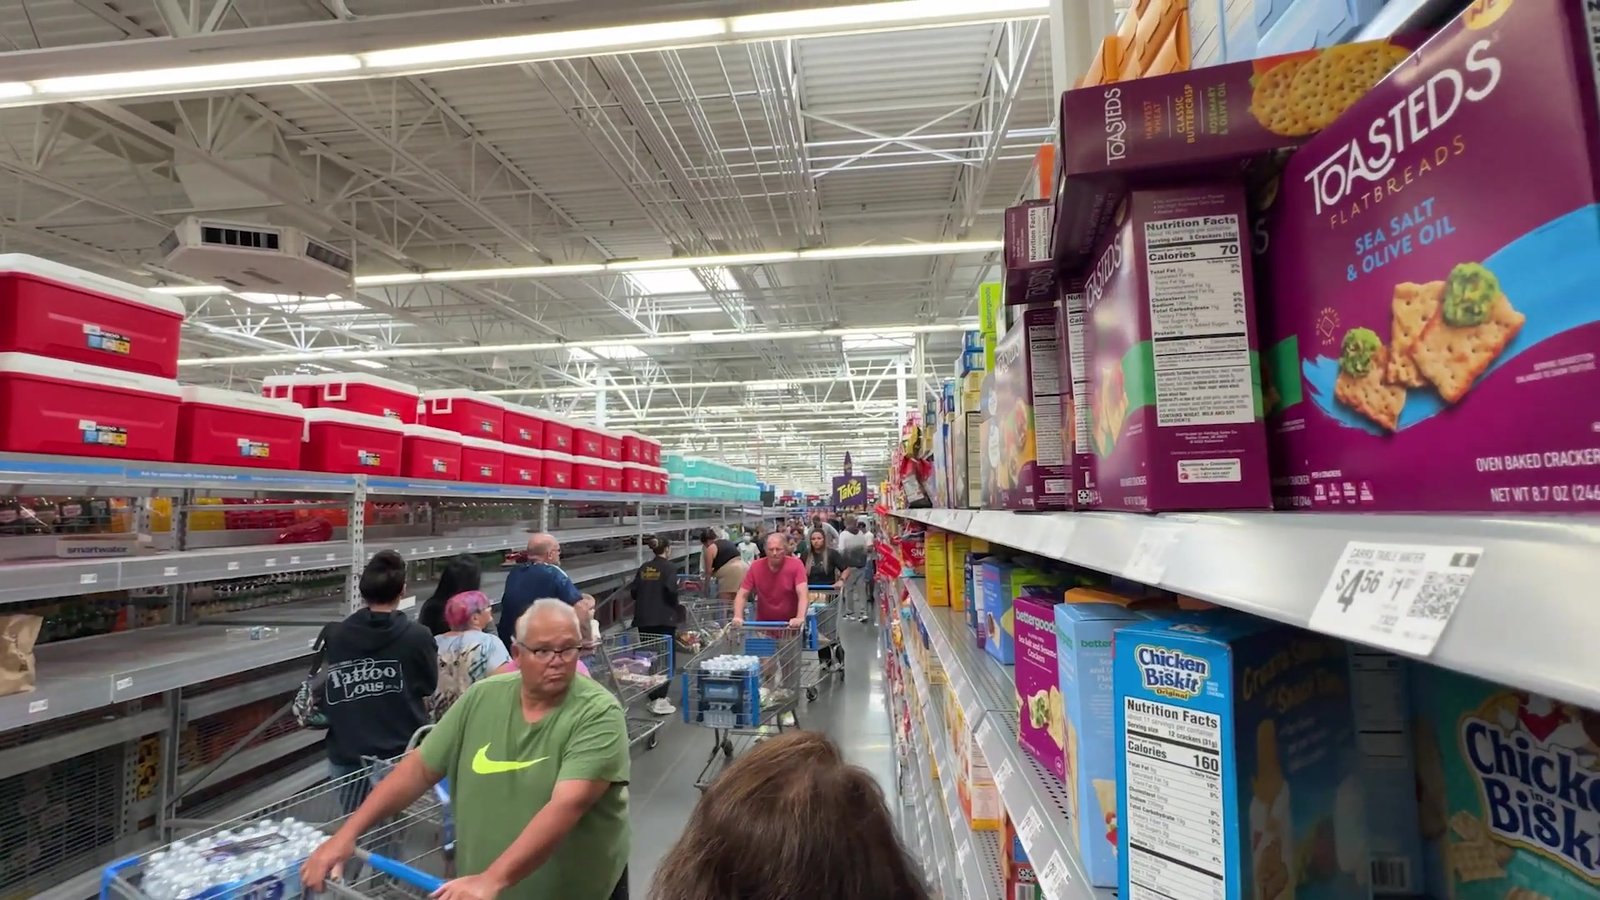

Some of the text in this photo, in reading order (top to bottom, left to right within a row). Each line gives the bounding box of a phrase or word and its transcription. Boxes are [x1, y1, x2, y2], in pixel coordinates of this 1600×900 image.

[1217, 82, 1226, 98] OIL
[1175, 96, 1185, 133] CLASSIC
[1184, 84, 1196, 144] BUTTERCRISP
[1207, 87, 1218, 135] ROSEMARY
[1103, 87, 1127, 166] TOASTEDS
[1304, 39, 1501, 216] TOASTEDS
[1330, 134, 1466, 230] FLATBREADS
[1146, 216, 1237, 231] Nutrition Facts
[1355, 197, 1435, 256] SEA SALT
[1149, 244, 1239, 262] Calories 70
[1346, 215, 1456, 282] & OLIVE OIL
[1084, 232, 1122, 313] TOASTEDS
[1476, 456, 1503, 472] OVEN
[1504, 453, 1542, 471] BAKED
[837, 482, 862, 503] Takis
[1490, 487, 1510, 502] NET
[1512, 486, 1529, 502] WT
[1531, 486, 1549, 502] 8.7
[1552, 485, 1570, 502] OZ
[67, 546, 128, 554] smartwater
[328, 658, 397, 689] Tattoo
[1138, 648, 1206, 674] Chicken
[1144, 668, 1199, 692] Biskit
[1156, 688, 1188, 700] Original
[1127, 699, 1218, 729] Nutrition Facts
[1127, 721, 1147, 732] Serving
[1147, 725, 1159, 733] size
[1176, 733, 1201, 744] crackers
[1202, 738, 1218, 748] (31g)
[1128, 741, 1219, 772] Calories 160
[1466, 721, 1600, 811] Chick
[1528, 788, 1555, 808] in a
[1142, 806, 1175, 821] Carbohydrate
[1482, 777, 1600, 870] Bisk
